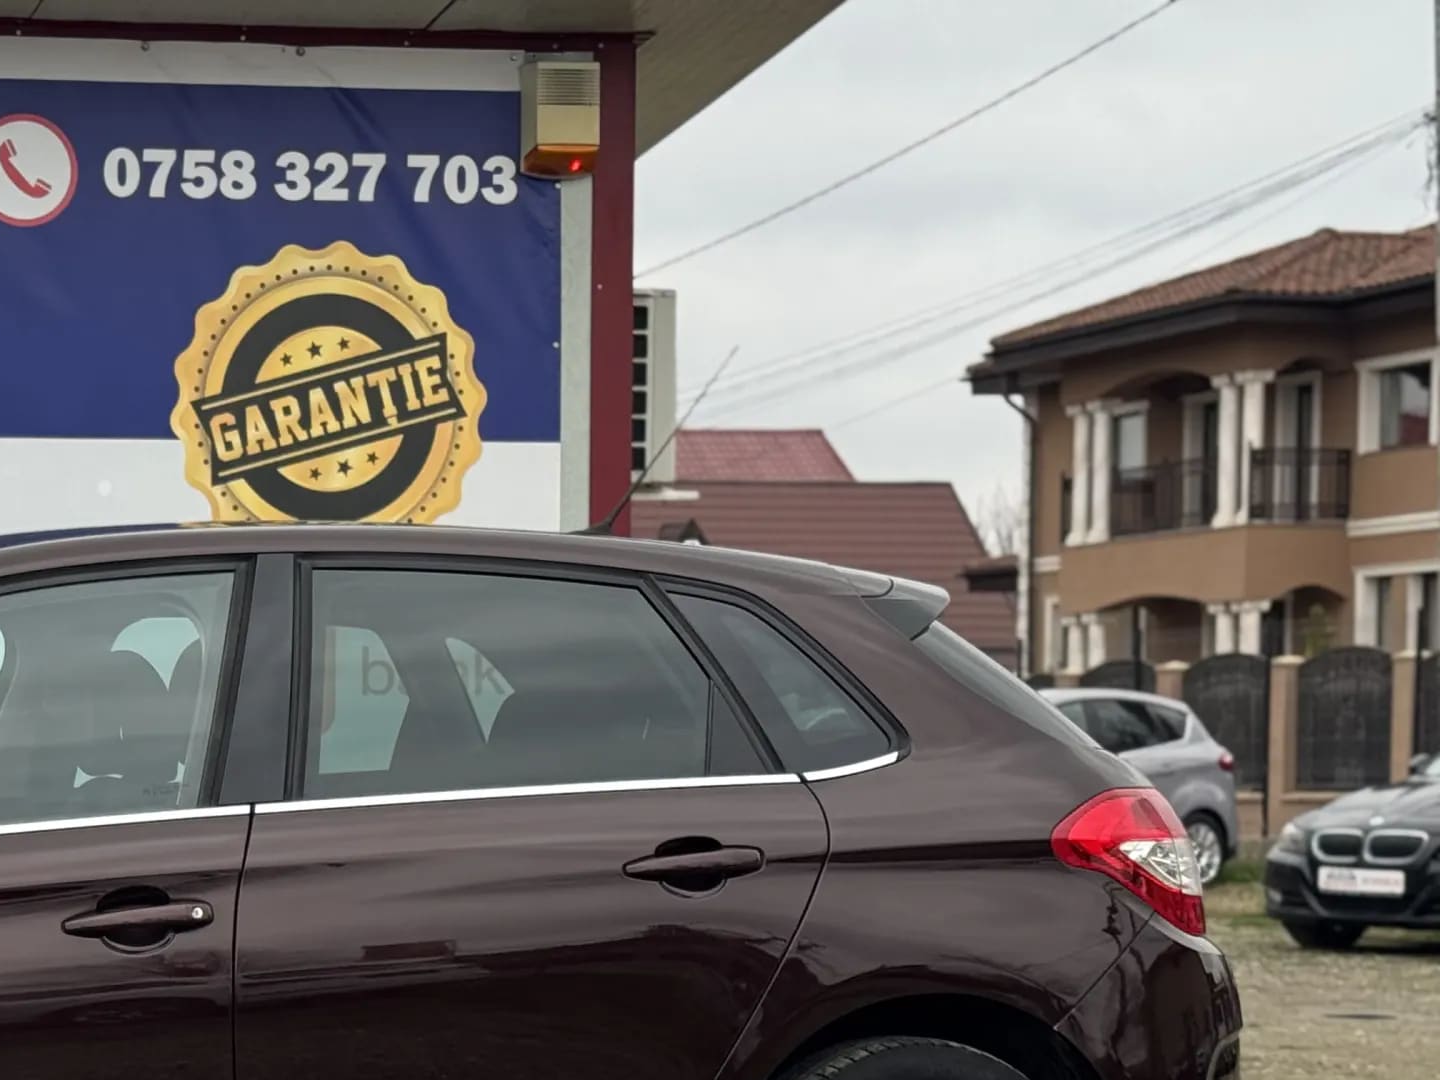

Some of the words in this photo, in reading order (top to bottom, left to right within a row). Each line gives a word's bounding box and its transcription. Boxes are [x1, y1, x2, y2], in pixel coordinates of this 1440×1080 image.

[103, 146, 258, 200] 0758
[273, 150, 387, 202] 327
[406, 153, 519, 205] 703
[361, 645, 506, 697] bk
